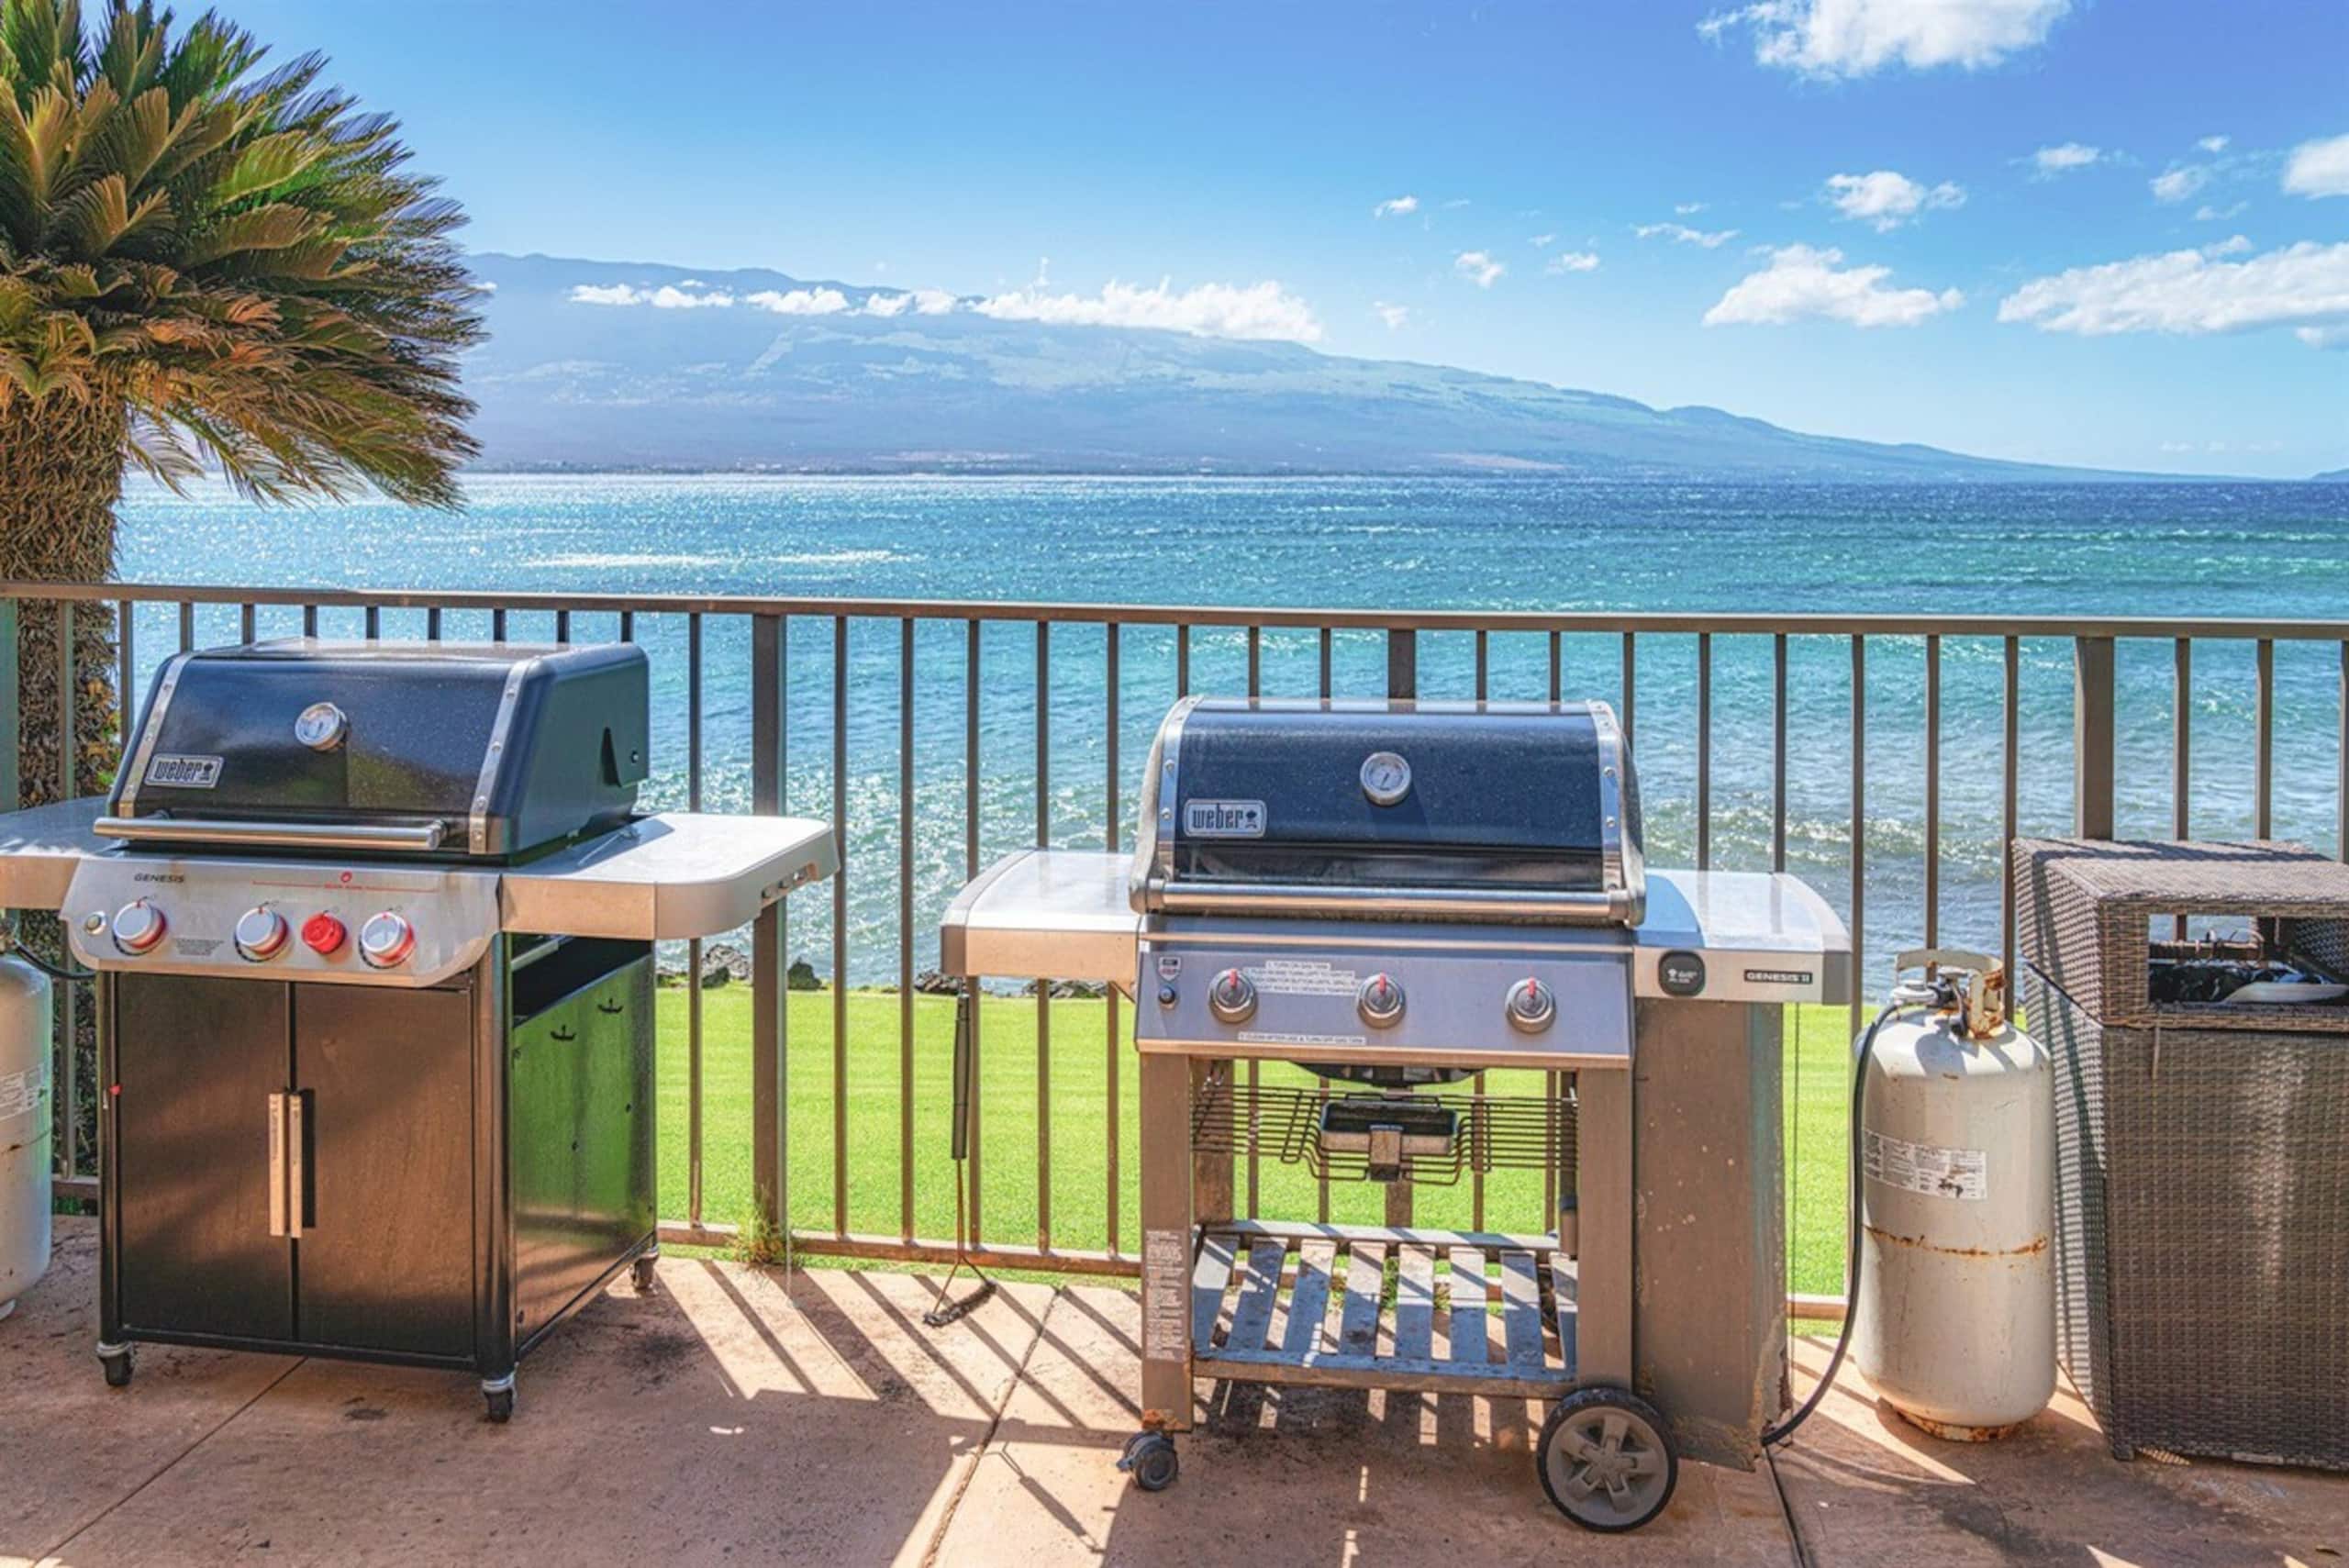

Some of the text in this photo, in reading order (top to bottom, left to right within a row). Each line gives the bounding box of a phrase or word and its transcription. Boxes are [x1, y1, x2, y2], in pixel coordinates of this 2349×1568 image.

[154, 758, 202, 779] weber
[1193, 803, 1243, 828] weber
[134, 873, 185, 883] GENESIS
[1746, 972, 1799, 982] GENESIS
